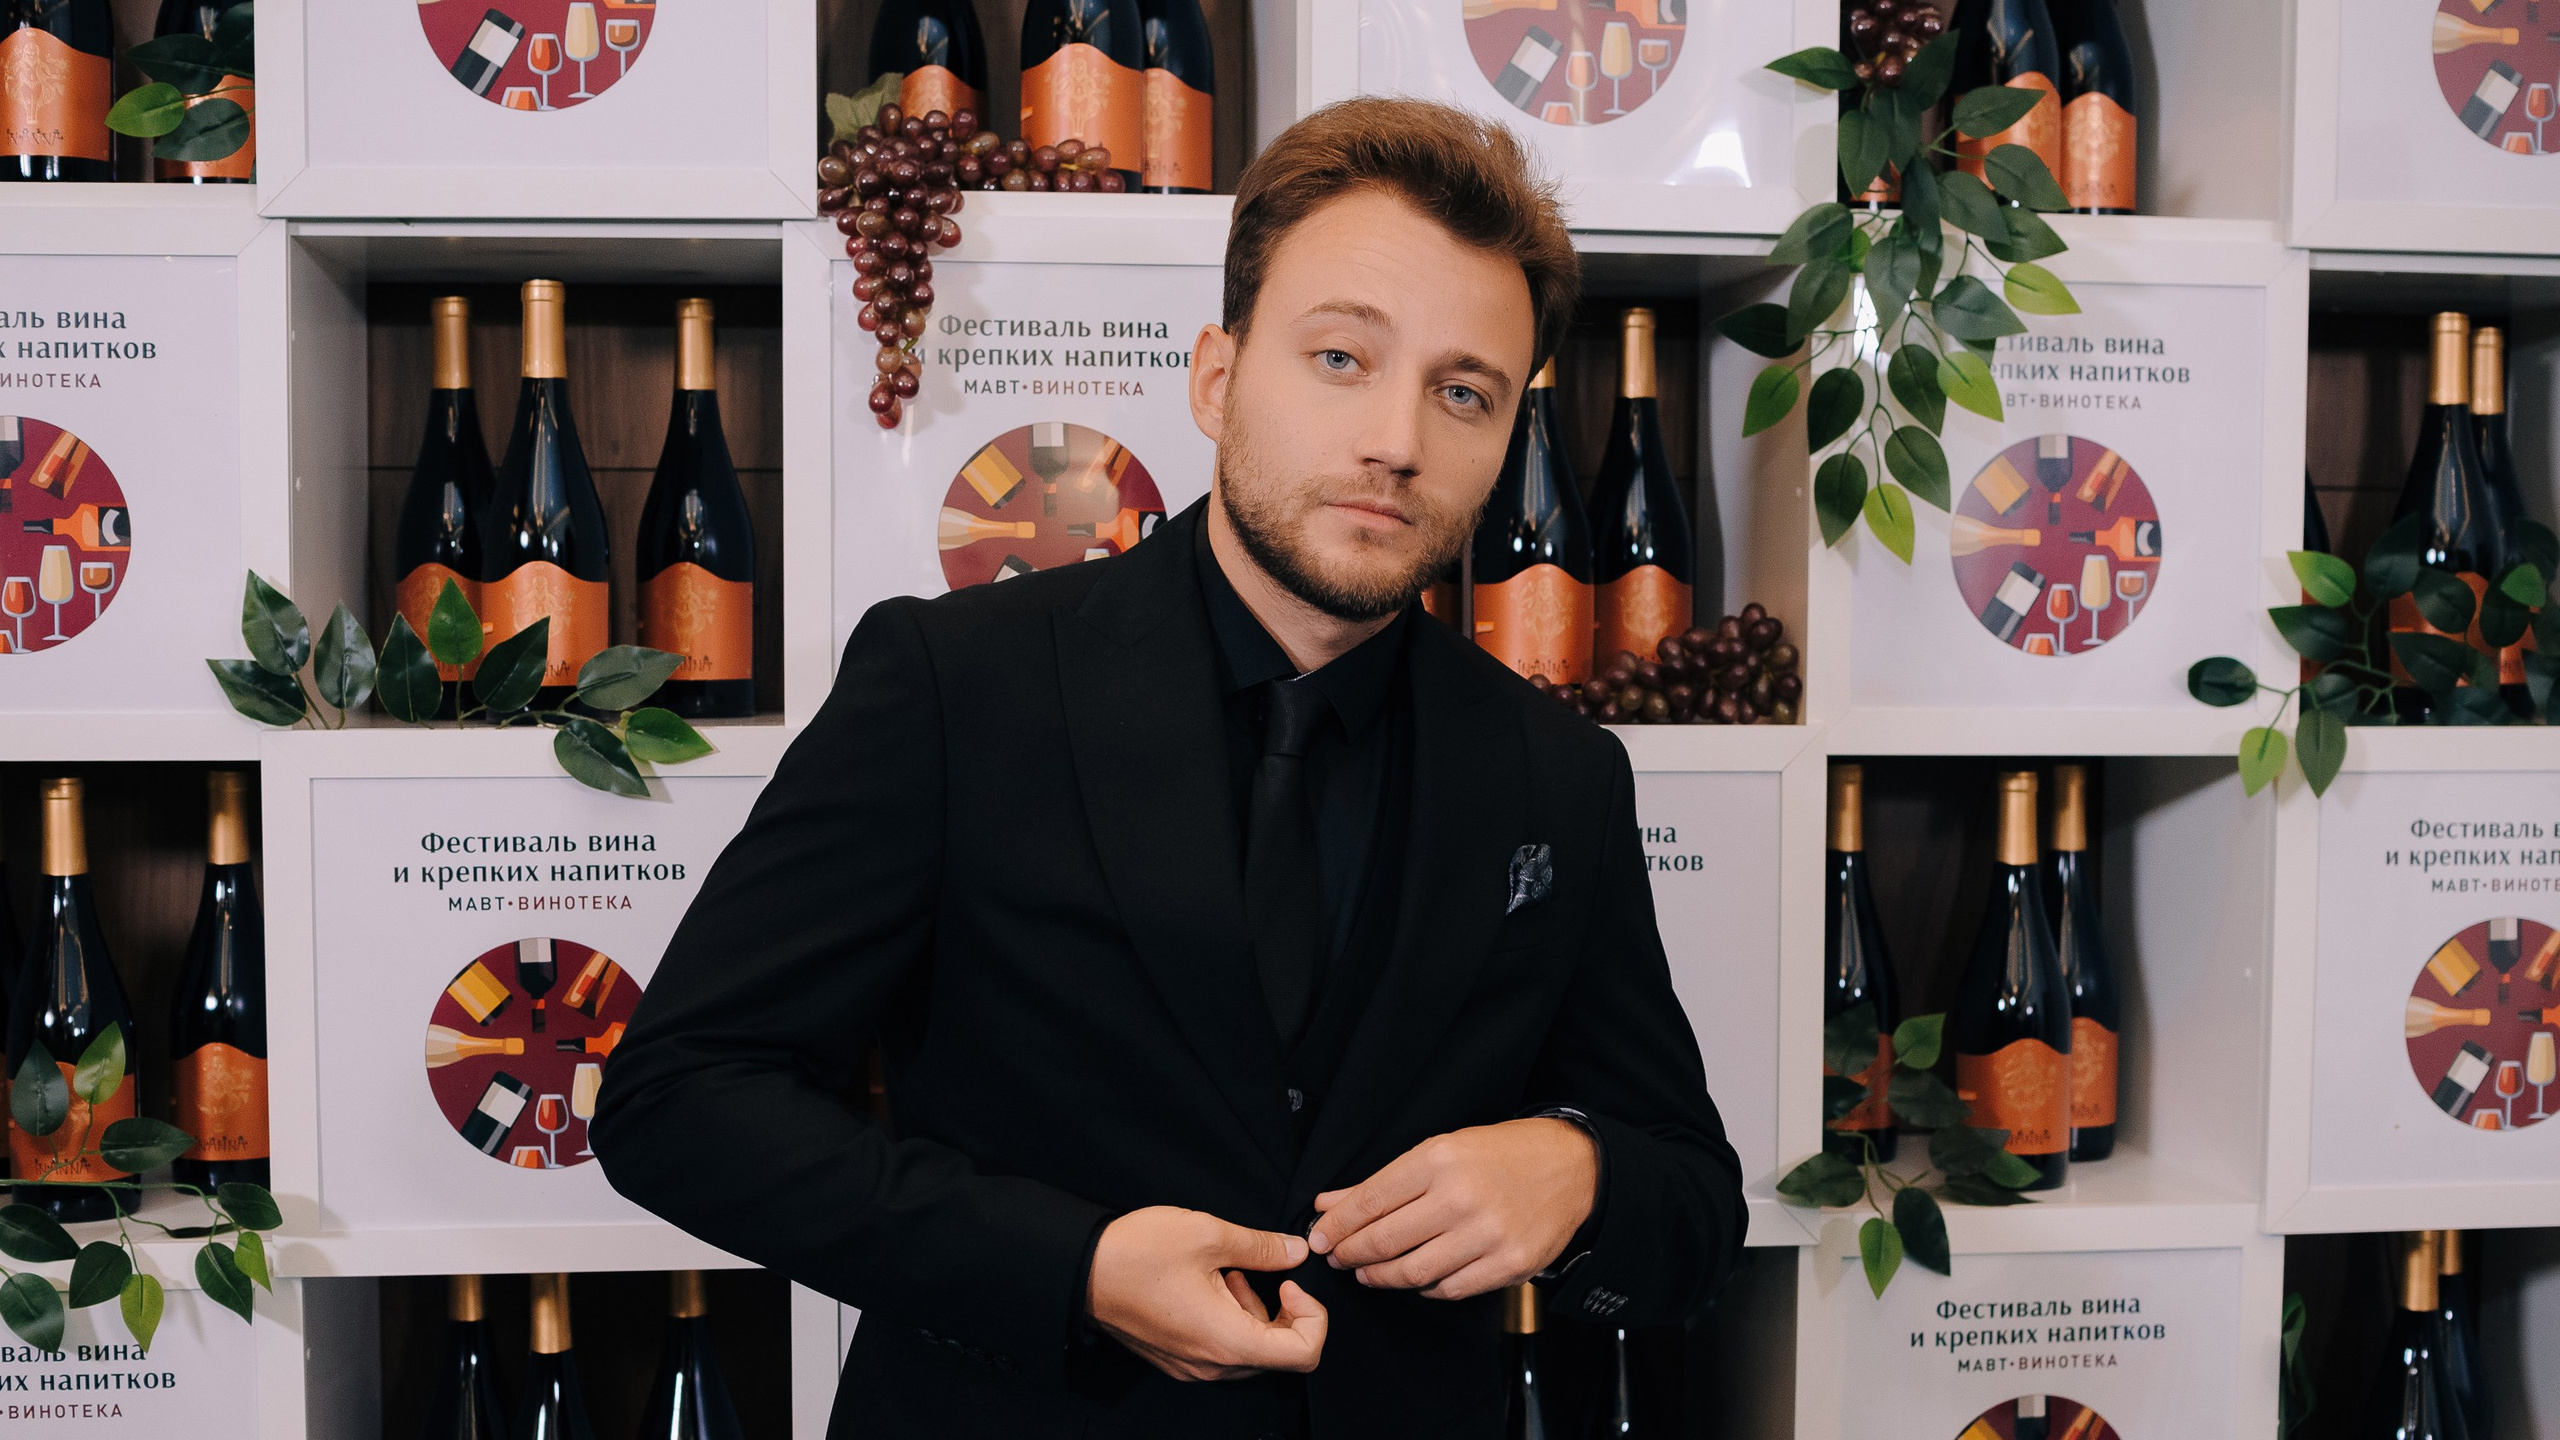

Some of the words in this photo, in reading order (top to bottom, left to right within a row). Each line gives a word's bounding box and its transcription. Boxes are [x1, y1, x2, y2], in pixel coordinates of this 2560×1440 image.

[56, 310, 127, 329] вина
[938, 314, 1092, 338] Фестиваль
[1102, 321, 1169, 339] вина
[17, 341, 157, 359] напитков
[1998, 335, 2094, 354] тиваль
[2104, 337, 2165, 355] вина
[938, 348, 1054, 373] крепких
[2069, 364, 2191, 384] напитков
[2410, 819, 2545, 839] Фестиваль
[420, 832, 578, 853] Фестиваль
[588, 833, 657, 852] вина
[2385, 850, 2399, 865] и
[2409, 849, 2511, 873] крепких
[393, 866, 410, 883] и
[421, 865, 540, 891] крепких
[551, 862, 687, 882] напитков
[1936, 1300, 2072, 1320] Фестиваль
[2081, 1297, 2142, 1316] вина
[1910, 1331, 1925, 1348] и
[1935, 1327, 2039, 1353] крепких
[2047, 1323, 2167, 1343] напитков
[77, 1343, 147, 1362] вина
[40, 1372, 177, 1391] напитков
